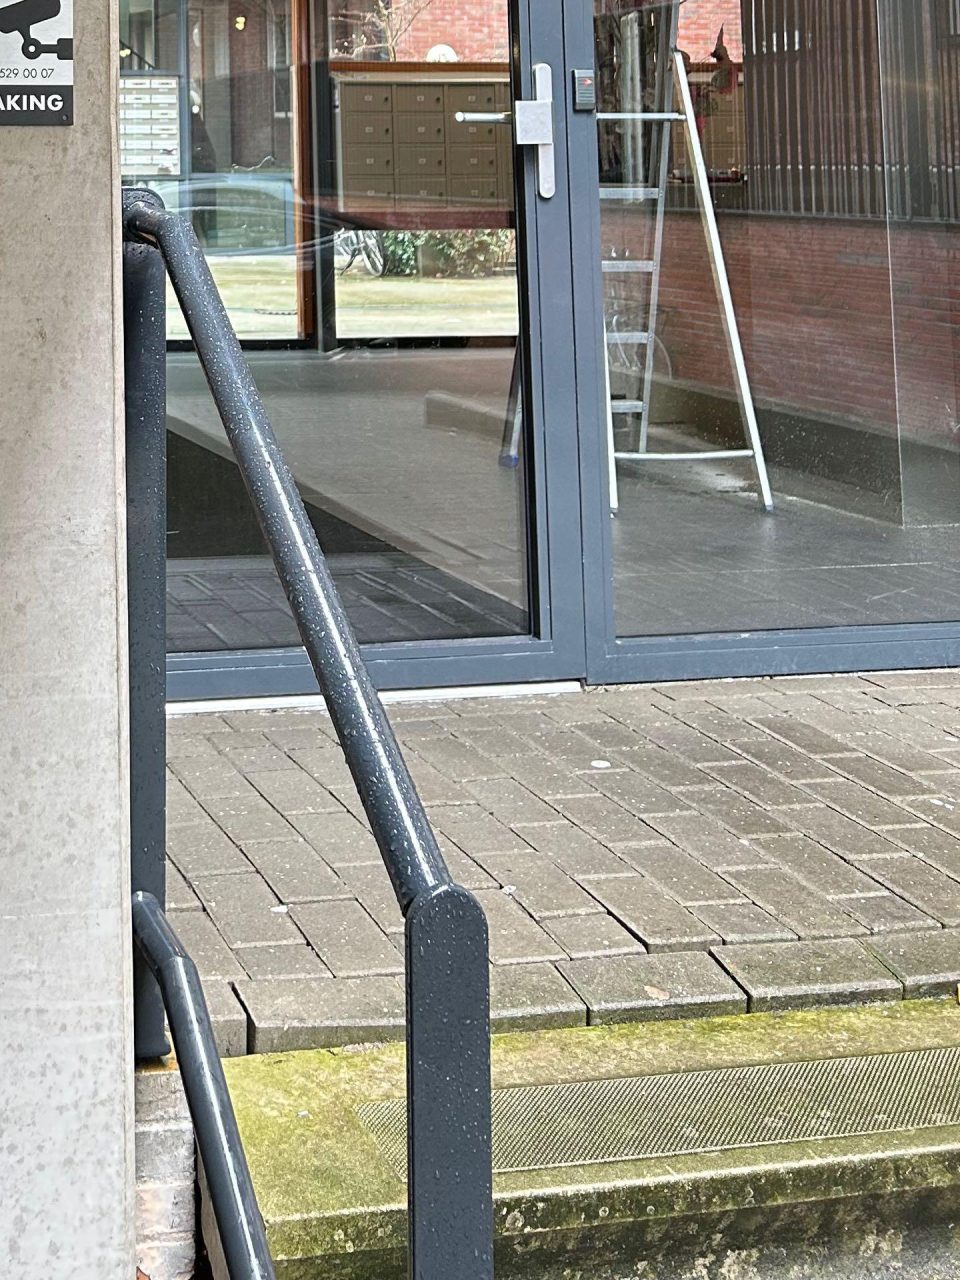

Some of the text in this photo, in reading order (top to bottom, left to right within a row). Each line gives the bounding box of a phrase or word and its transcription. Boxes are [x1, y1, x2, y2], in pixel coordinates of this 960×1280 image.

[0, 67, 20, 79] 529
[22, 67, 38, 79] 00
[40, 68, 55, 79] 07
